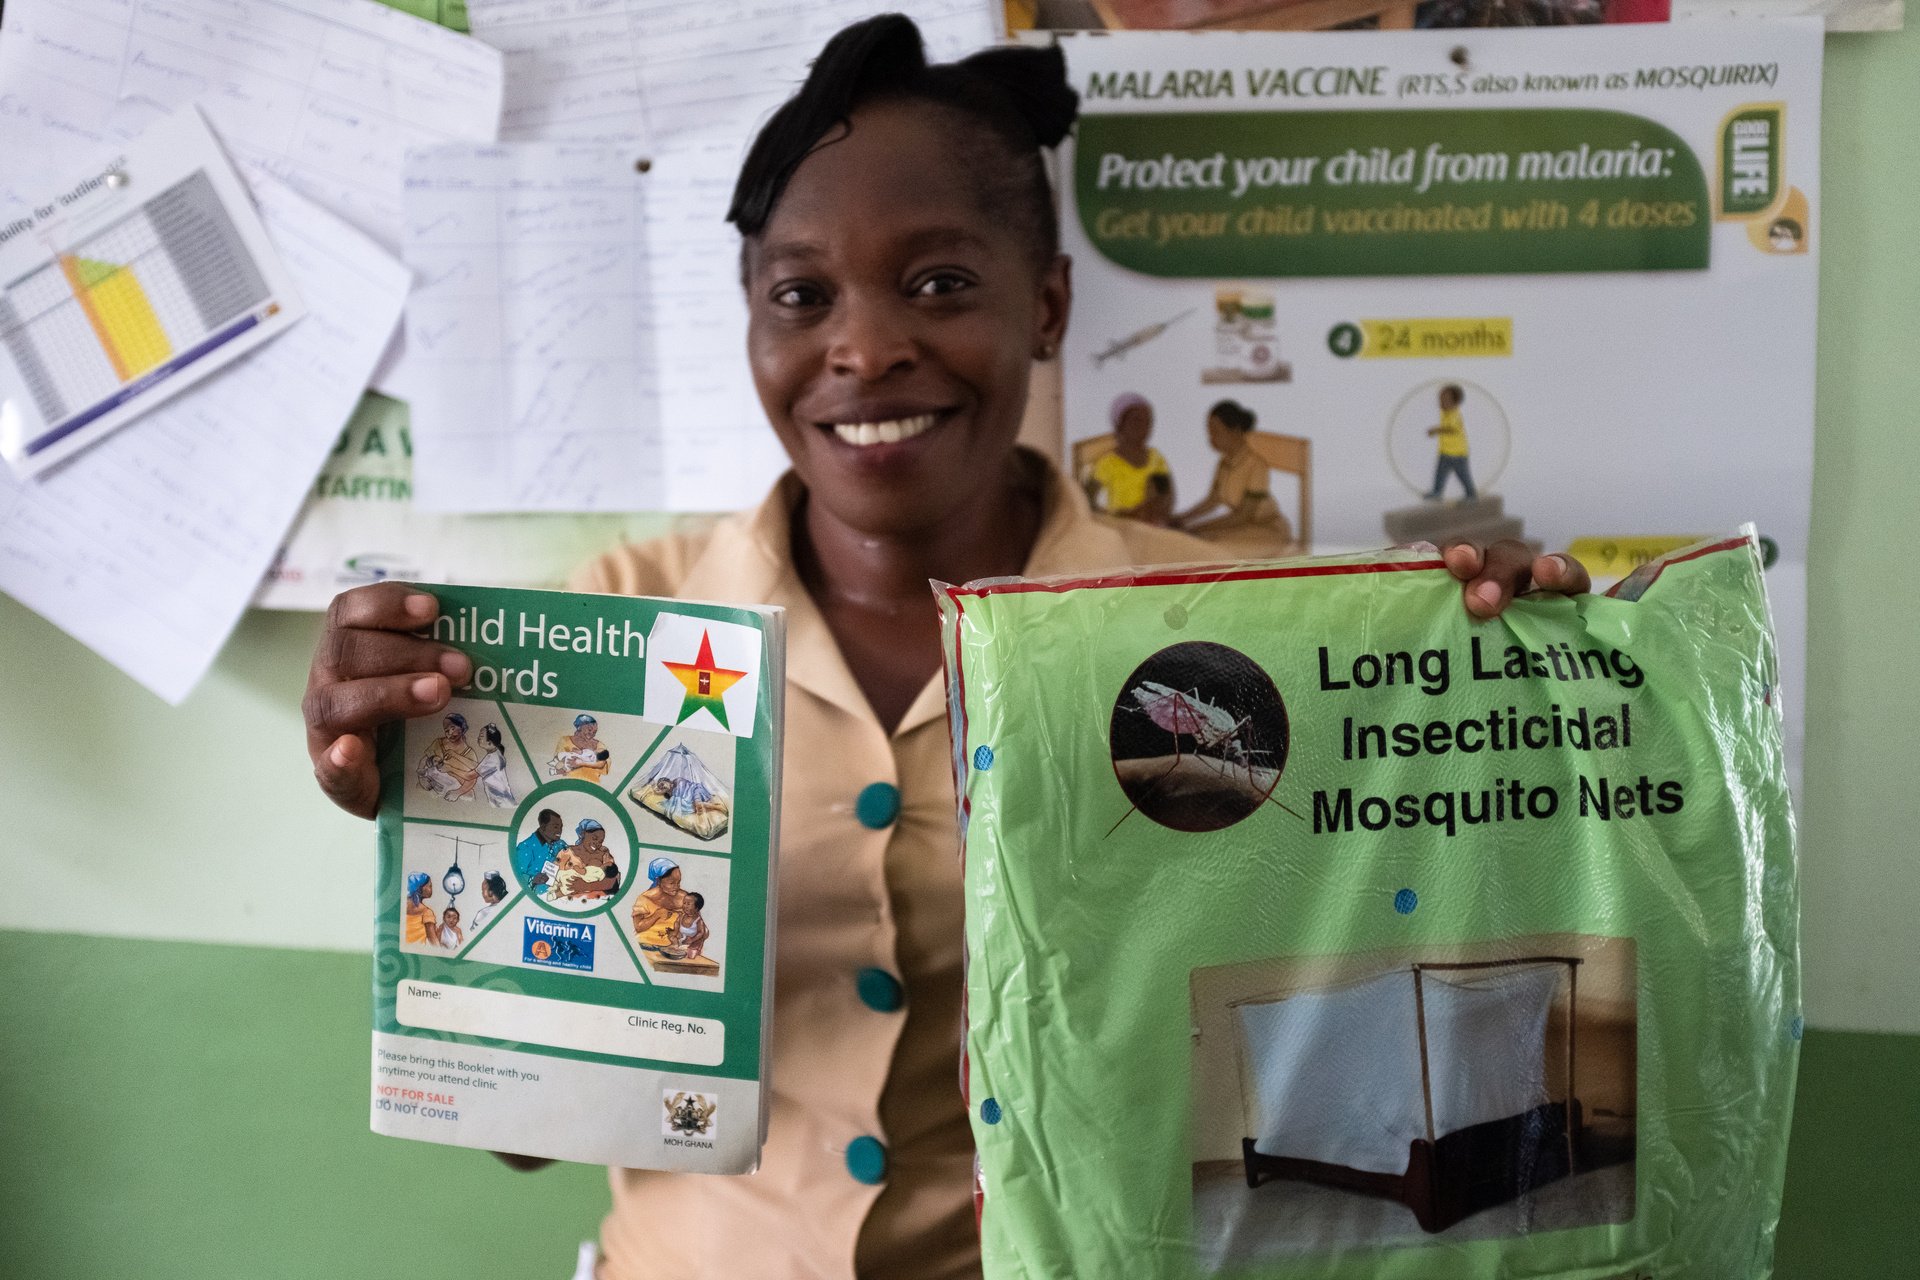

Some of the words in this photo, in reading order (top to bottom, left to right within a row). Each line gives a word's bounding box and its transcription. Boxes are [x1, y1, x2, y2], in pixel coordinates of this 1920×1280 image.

[1087, 70, 1235, 100] MALARIA
[1246, 66, 1390, 98] VACCINE
[1472, 72, 1518, 94] also
[1523, 69, 1599, 93] known
[1604, 72, 1629, 90] as
[1633, 62, 1778, 91] MOSQUIRIX)
[1096, 152, 1225, 190] Protect
[1231, 153, 1321, 198] your
[1323, 147, 1417, 186] child
[1416, 142, 1510, 195] from
[1516, 141, 1677, 181] malaria:
[1733, 137, 1770, 197] LIFE
[1096, 207, 1150, 240] Get
[1156, 209, 1232, 247] your
[1236, 204, 1316, 237] child
[1322, 202, 1492, 236] vaccinated
[1500, 199, 1570, 231] with
[1577, 202, 1600, 229] 4
[1605, 198, 1698, 230] doses
[1376, 323, 1411, 351] 24
[1420, 321, 1507, 350] months
[413, 607, 505, 645] hild
[518, 611, 646, 659] Health
[462, 659, 559, 698] ords
[1317, 646, 1450, 696] Long
[1470, 636, 1646, 688] Lasting
[1342, 703, 1632, 761] Insecticidal
[1312, 777, 1560, 837] Mosquito
[1578, 774, 1685, 822] Nets
[526, 918, 578, 939] Vitamin
[581, 926, 592, 940] A
[535, 942, 548, 957] A
[407, 985, 442, 1000] Name:
[627, 1015, 659, 1030] Clinic
[660, 1019, 686, 1035] Reg.
[687, 1023, 707, 1035] No.
[377, 1049, 408, 1063] Please
[409, 1052, 436, 1069] bring
[437, 1058, 456, 1070] this
[457, 1061, 495, 1076] Booklet
[496, 1067, 519, 1078] with
[520, 1071, 540, 1083] you
[377, 1065, 415, 1079] anytime
[417, 1070, 436, 1083] you
[437, 1073, 471, 1087] attend
[472, 1078, 498, 1091] clinic
[375, 1099, 392, 1112] DO
[394, 1101, 419, 1116] NOT
[420, 1106, 459, 1121] COVER
[376, 1085, 399, 1098] NOT
[401, 1088, 424, 1101] FOR
[426, 1092, 455, 1106] SALE
[663, 1138, 684, 1147] MOH
[684, 1140, 714, 1150] GHANA
